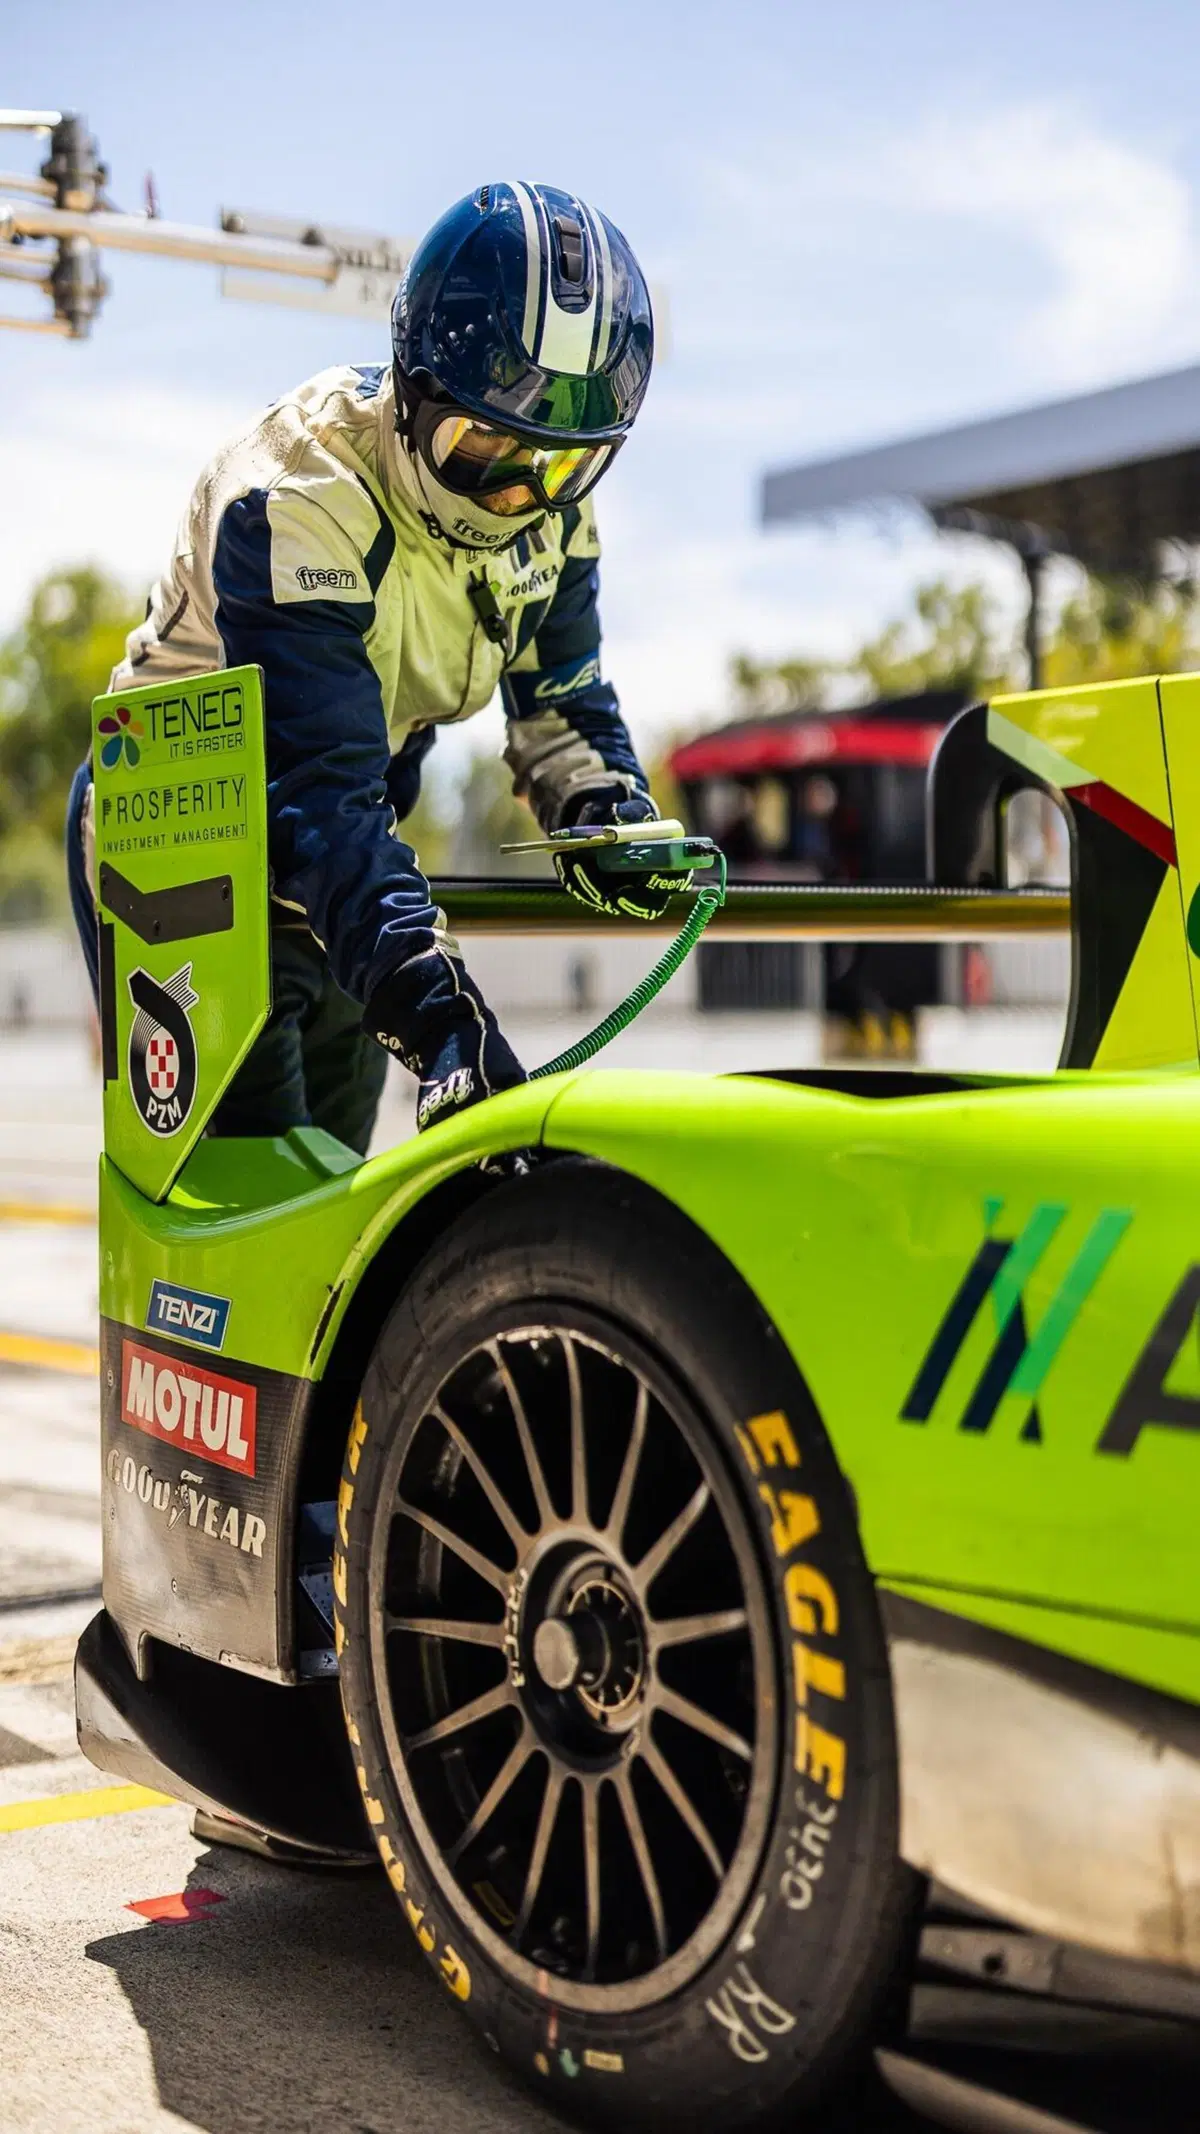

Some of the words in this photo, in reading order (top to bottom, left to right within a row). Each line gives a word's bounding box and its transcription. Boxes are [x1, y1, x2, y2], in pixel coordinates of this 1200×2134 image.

[297, 567, 356, 590] freem
[144, 687, 242, 741] TENEG
[170, 743, 180, 758] IT
[183, 740, 194, 756] IS
[197, 732, 243, 754] FASTER
[102, 777, 244, 826] PROSPERITY
[103, 834, 166, 852] INVESTMENT
[174, 823, 245, 844] MANAGEMENT
[146, 1096, 182, 1129] PZM
[157, 1294, 218, 1334] TENZI
[126, 1356, 249, 1461] MOTUL
[734, 1410, 846, 1800] EAGLE
[705, 1961, 797, 2062] RR
